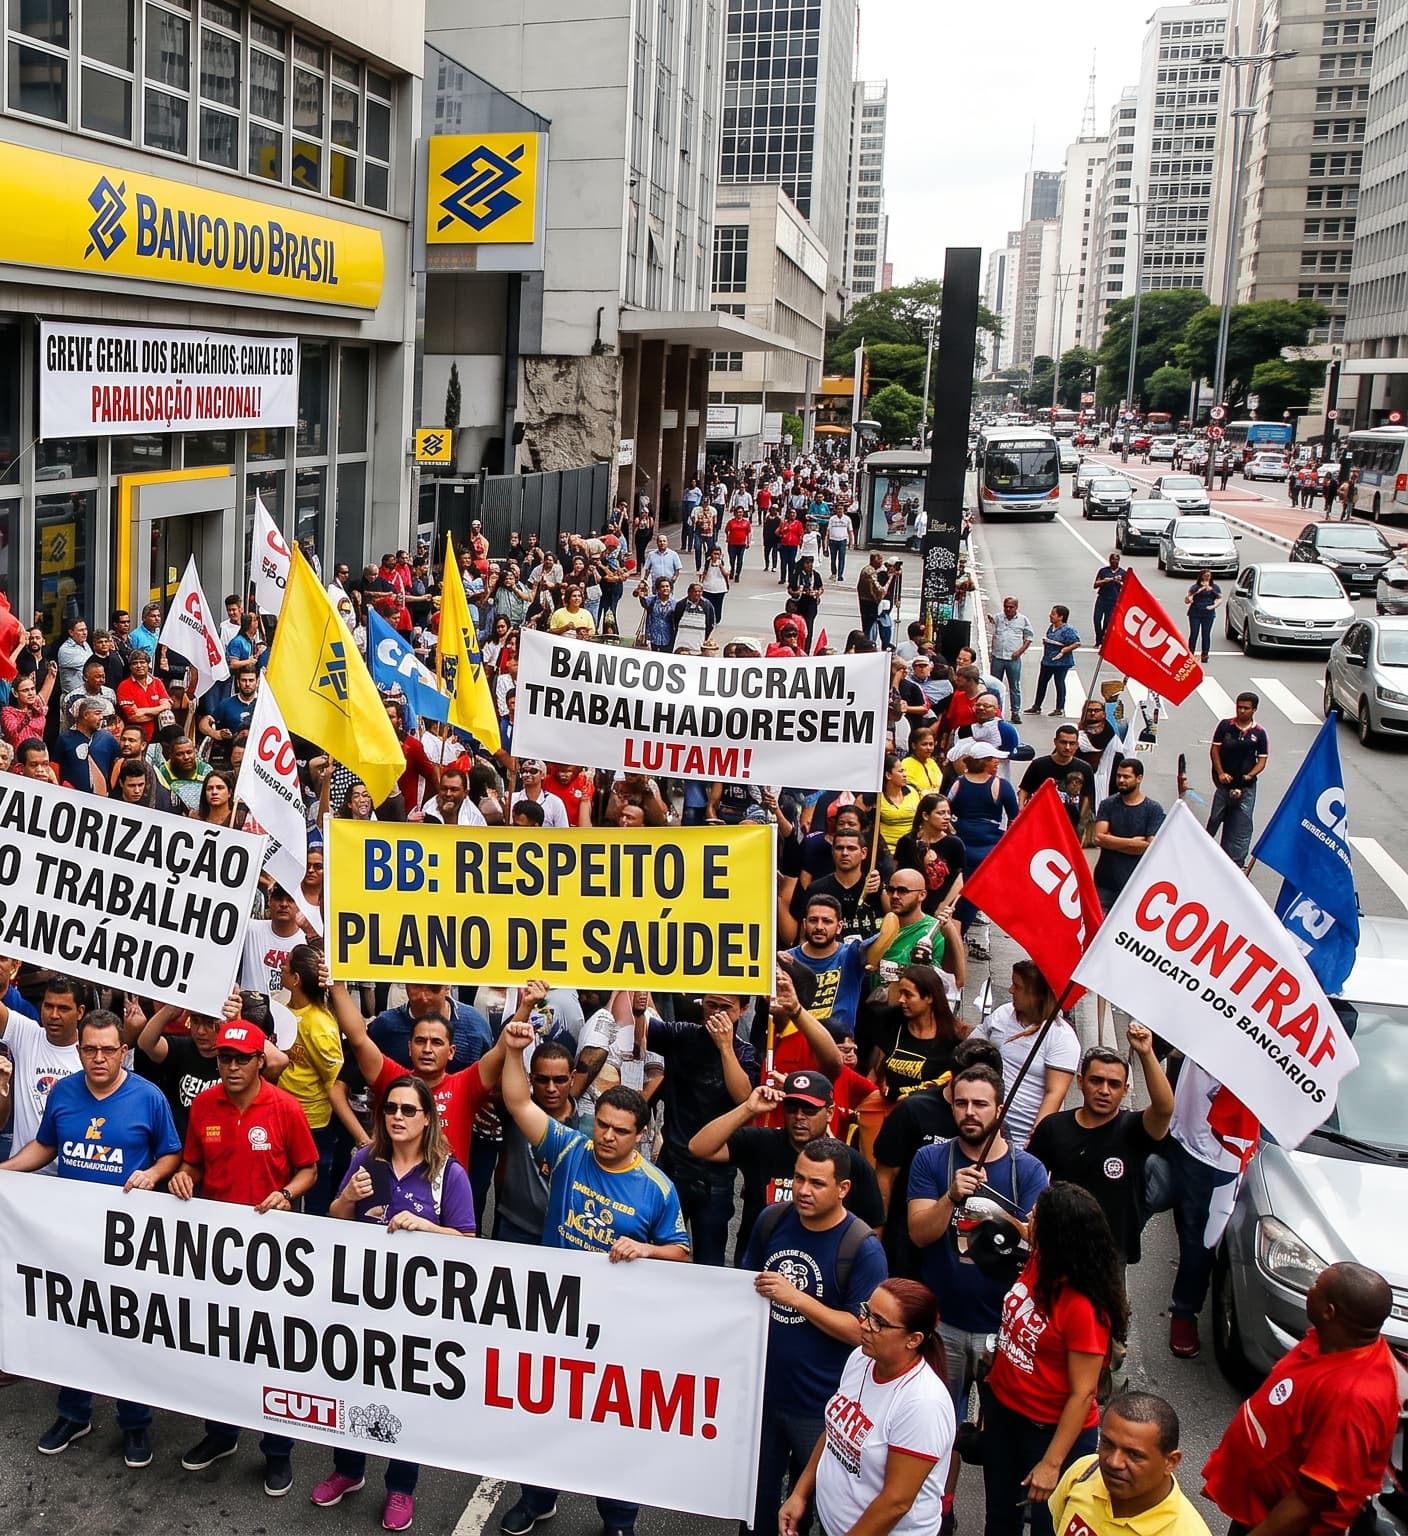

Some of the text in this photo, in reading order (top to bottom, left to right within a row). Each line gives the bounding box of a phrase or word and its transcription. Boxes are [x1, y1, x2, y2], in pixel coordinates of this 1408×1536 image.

[135, 192, 339, 287] BANCO DO BRASIL
[46, 334, 294, 376] GREVE GERAL DOS BANCÁRIOS: CAIXA E BB
[92, 378, 262, 428] PARALISAÇÃO NACIONAL!
[1123, 606, 1189, 667] CUT
[550, 646, 856, 706] BANCOS LUCRAM,
[525, 683, 875, 744] TRABALHADORESEM
[623, 738, 753, 779] LUTAM!
[363, 838, 730, 900] BB: RESPEITO E
[34, 854, 239, 947] TRABALHO
[337, 908, 761, 978] PLANO DE SAÚDE!
[1135, 881, 1336, 1068] CONTRAF
[1114, 930, 1327, 1105] SINDICATO DOS BANCÁRIOS
[62, 1141, 123, 1164] CAIXA
[103, 1209, 603, 1352] BANCOS LUCRAM,
[15, 1264, 467, 1401] TRABALHADORES
[483, 1346, 721, 1441] LUTAM!
[264, 1390, 335, 1424] CUT
